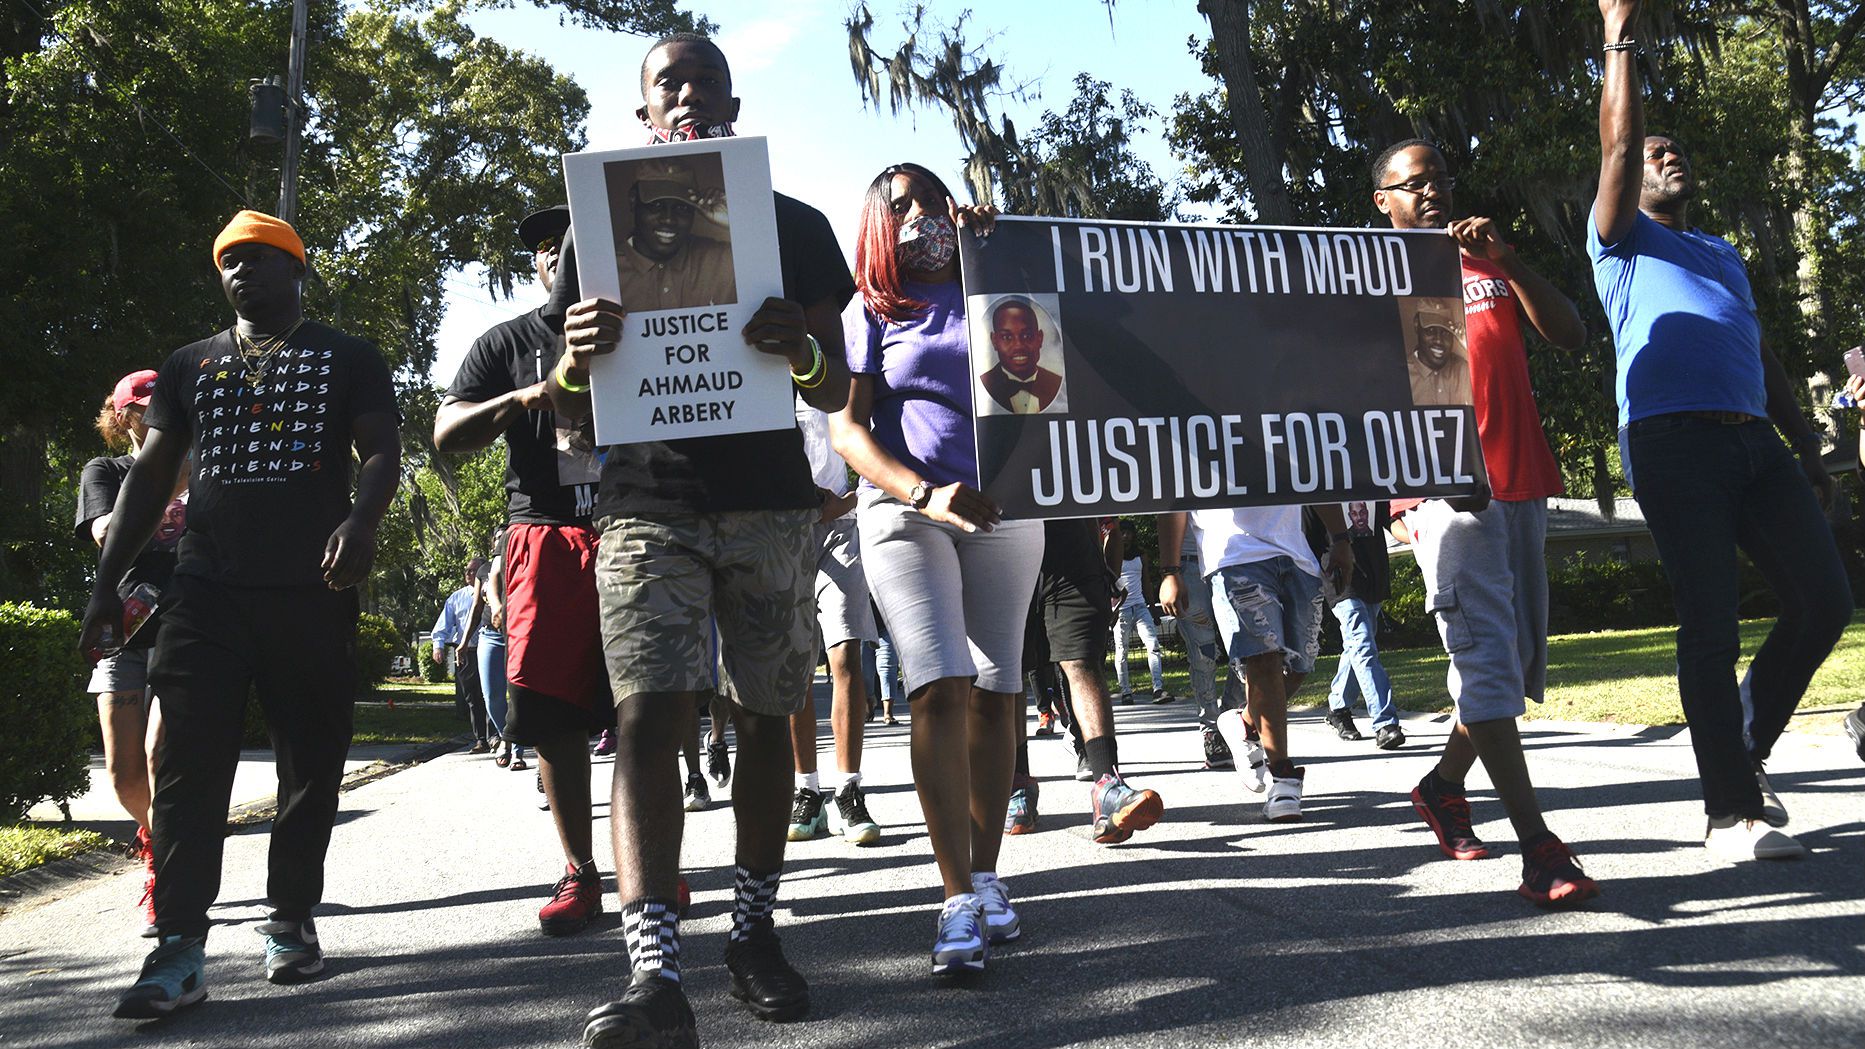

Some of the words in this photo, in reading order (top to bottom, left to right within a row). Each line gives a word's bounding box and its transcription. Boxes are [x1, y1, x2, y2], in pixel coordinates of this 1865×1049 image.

[1050, 225, 1065, 293] I
[1079, 226, 1174, 293] RUN
[1181, 229, 1290, 294] WITH
[1297, 233, 1413, 296] MAUD
[1463, 279, 1508, 304] ORS
[641, 312, 728, 338] JUSTICE
[665, 344, 710, 365] FOR
[638, 370, 743, 397] AHMAUD
[651, 401, 735, 425] ARBERY
[1031, 414, 1247, 506] JUSTICE
[1261, 411, 1352, 494] FOR
[1363, 409, 1474, 494] QUEZ
